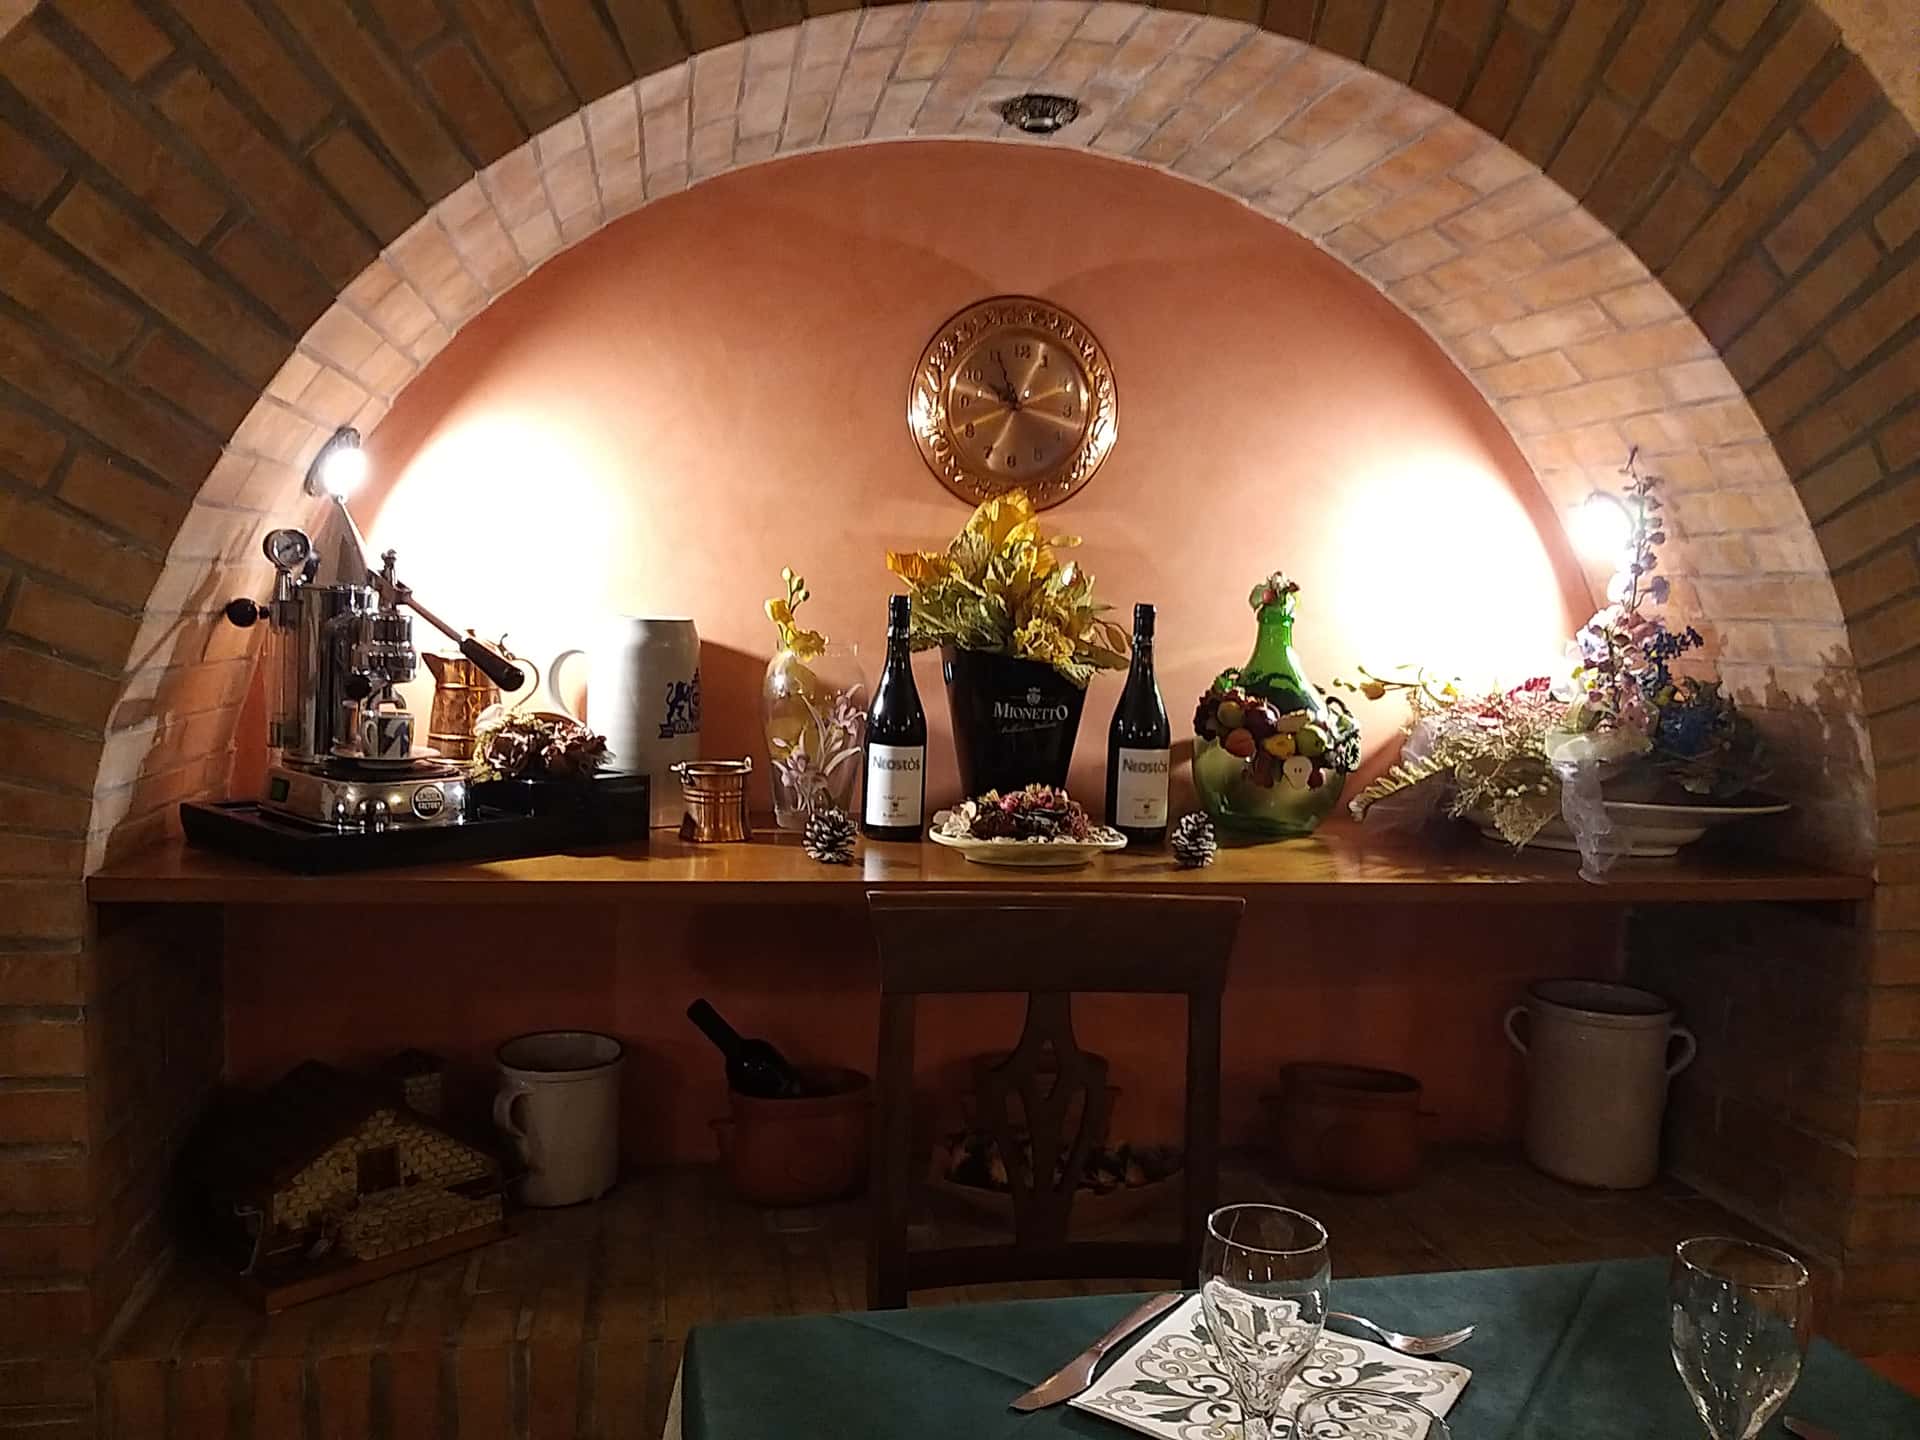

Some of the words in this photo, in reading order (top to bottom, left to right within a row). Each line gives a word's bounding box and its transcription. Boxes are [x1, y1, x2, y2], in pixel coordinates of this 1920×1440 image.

[1014, 344, 1031, 359] 12
[965, 423, 975, 438] 8
[1006, 455, 1016, 468] 6
